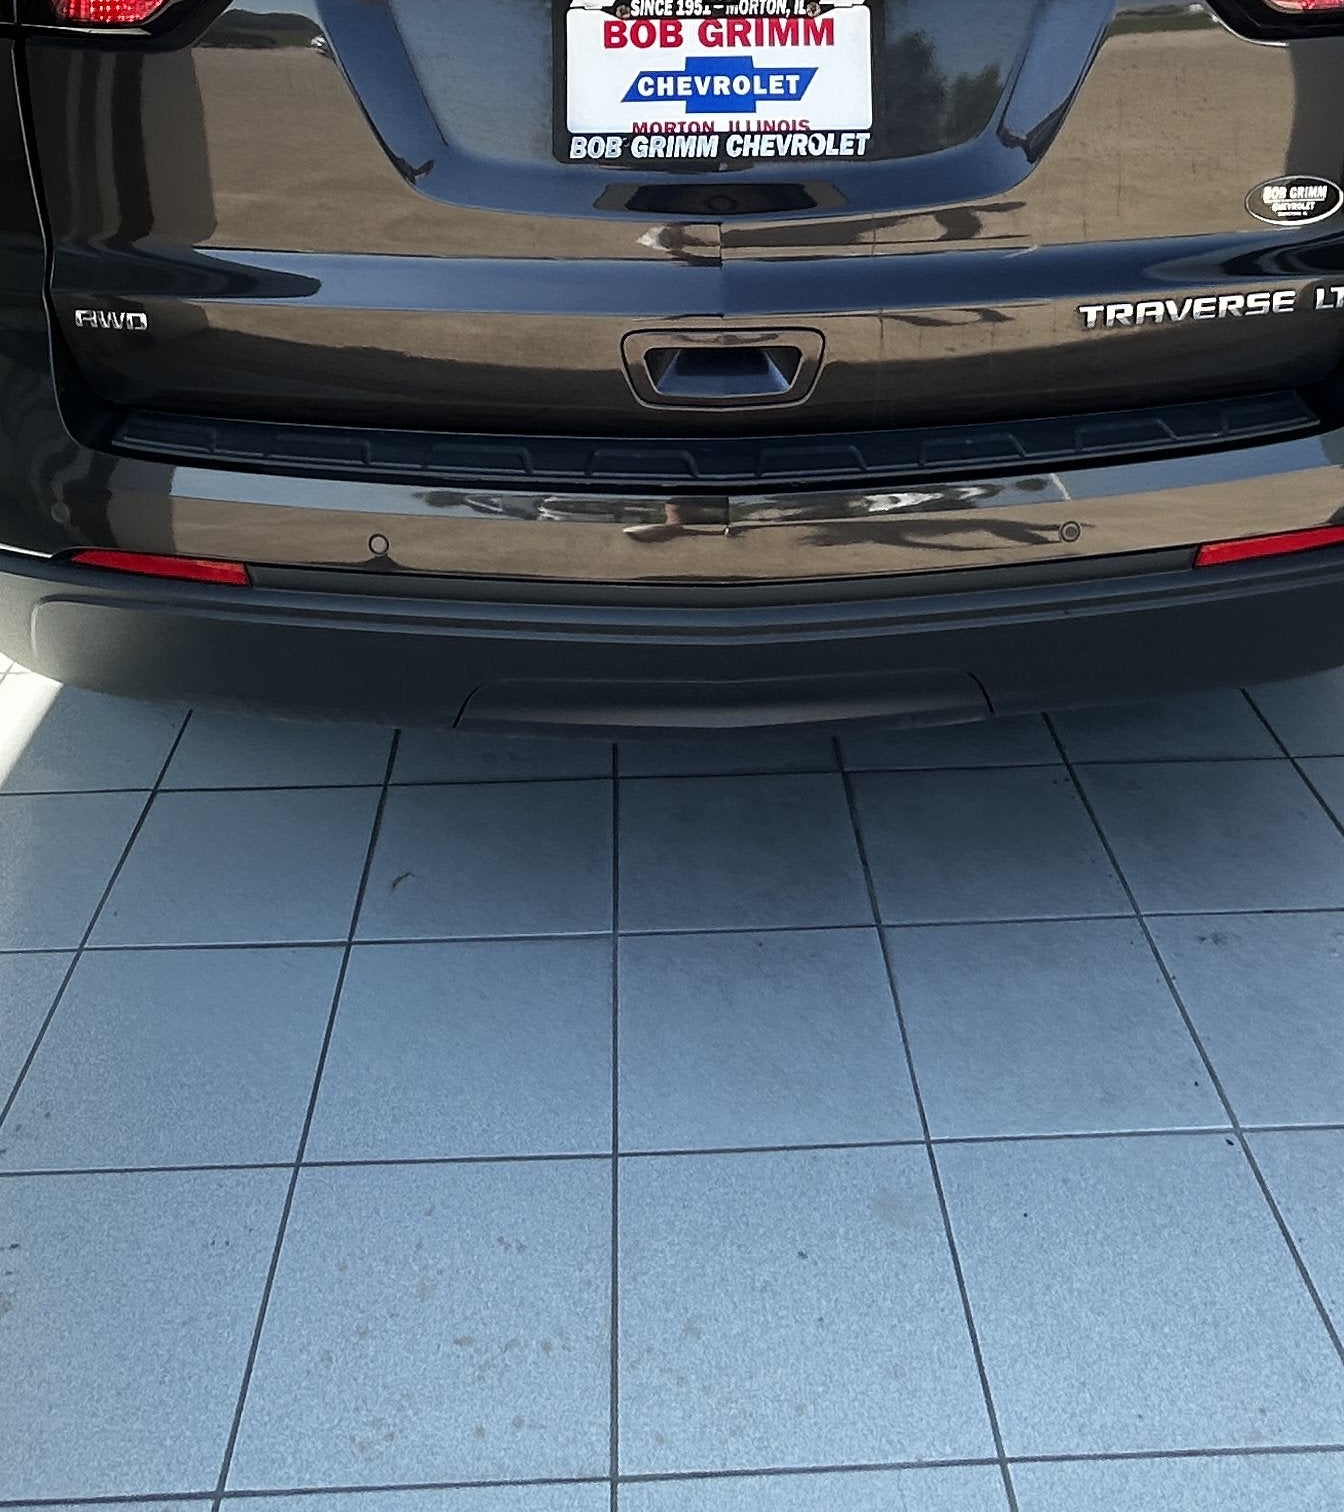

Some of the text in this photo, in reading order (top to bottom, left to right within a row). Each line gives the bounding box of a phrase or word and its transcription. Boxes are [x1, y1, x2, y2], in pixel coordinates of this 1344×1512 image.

[603, 17, 835, 49] BOB GRIMM
[637, 74, 801, 97] CHEVROLET
[632, 120, 716, 135] MORTON
[569, 132, 871, 159] BOB GRIMM CHEVROLET
[1262, 185, 1328, 201] BOB GRIMM
[75, 309, 148, 330] AWD
[1078, 290, 1297, 330] TRAVERSE
